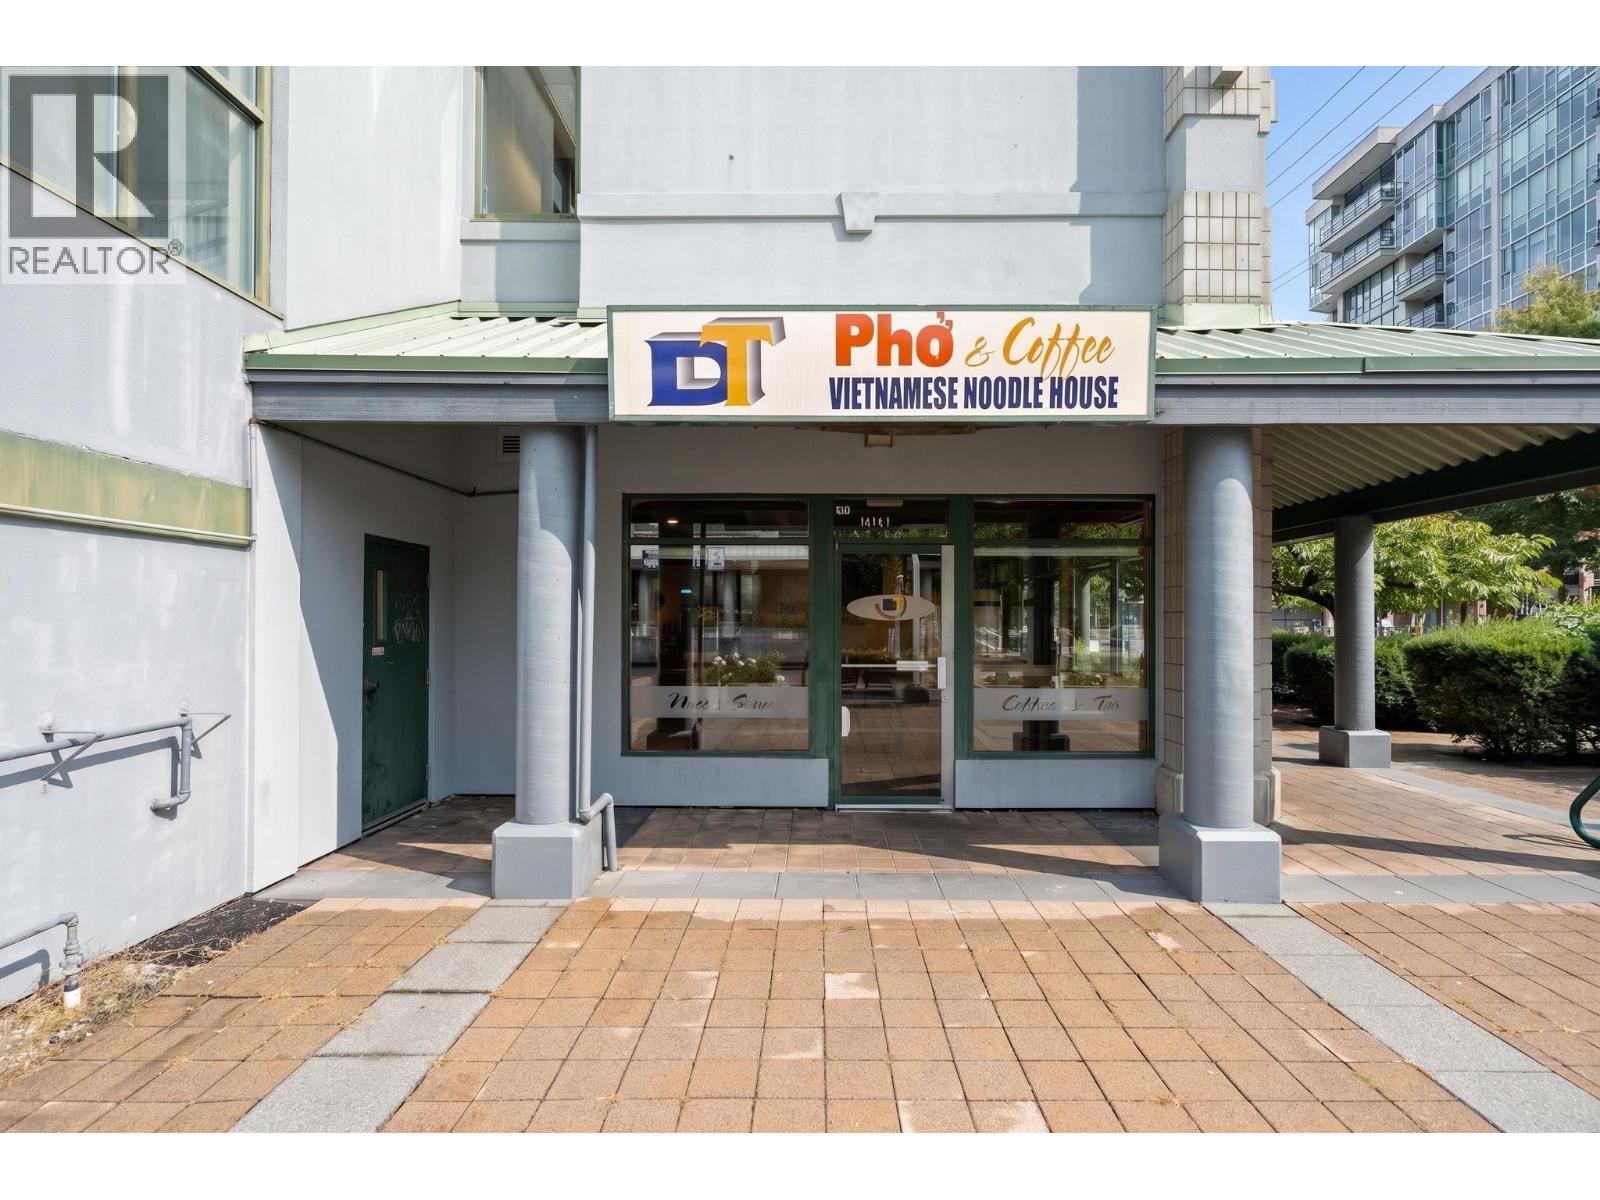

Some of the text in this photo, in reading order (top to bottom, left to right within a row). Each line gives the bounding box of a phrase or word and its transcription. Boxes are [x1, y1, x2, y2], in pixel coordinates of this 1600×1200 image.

[644, 317, 787, 407] DT
[965, 336, 996, 367] &
[1002, 316, 1116, 381] Coffee
[828, 375, 1119, 409] VIETNAMESE NOODLE HOUSE
